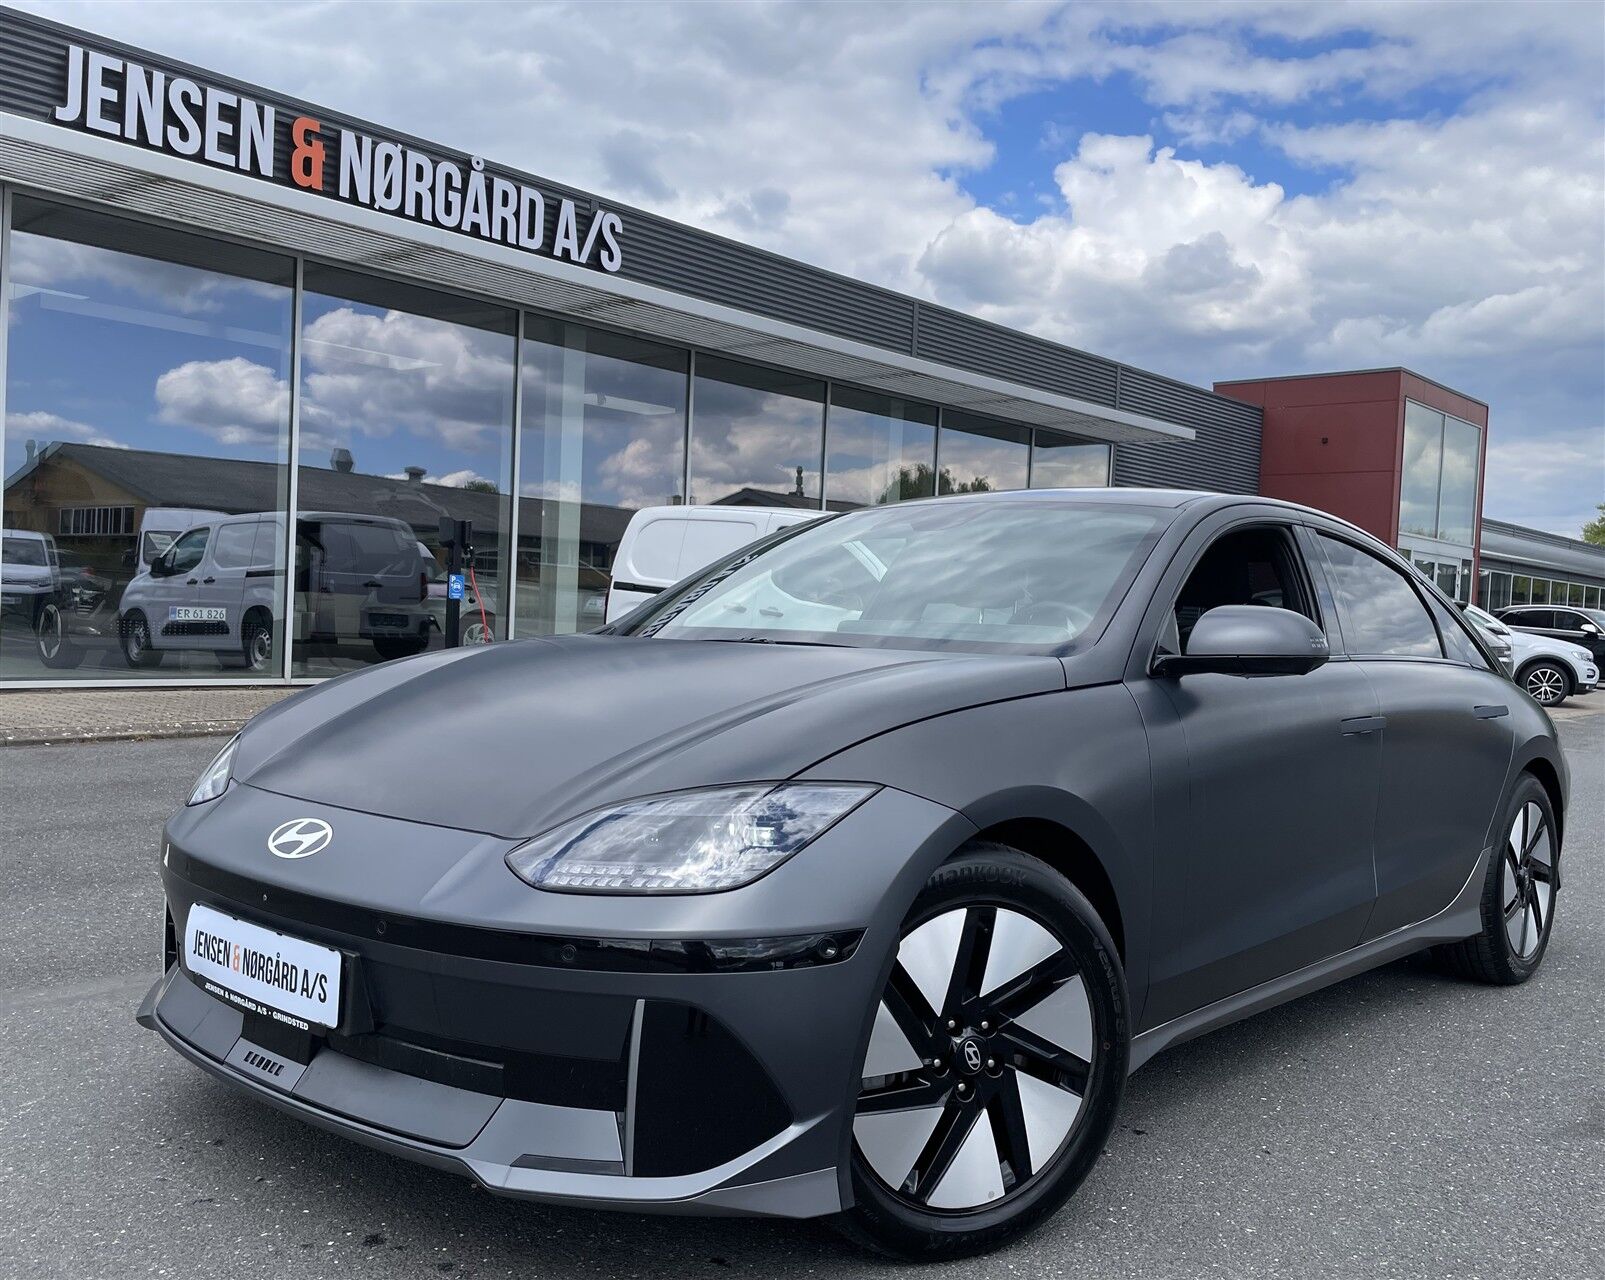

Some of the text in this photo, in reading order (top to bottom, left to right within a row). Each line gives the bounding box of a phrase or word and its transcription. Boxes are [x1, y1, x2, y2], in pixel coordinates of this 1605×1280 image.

[54, 44, 624, 273] JENSEN & NØRGÅRD A/S
[177, 608, 225, 620] ER 61 826
[193, 929, 328, 1004] JENSEN & NØRGÅRD A/S
[204, 982, 224, 996] JENSEN
[257, 1005, 268, 1016] A/S
[272, 1011, 309, 1031] GRINDSTED
